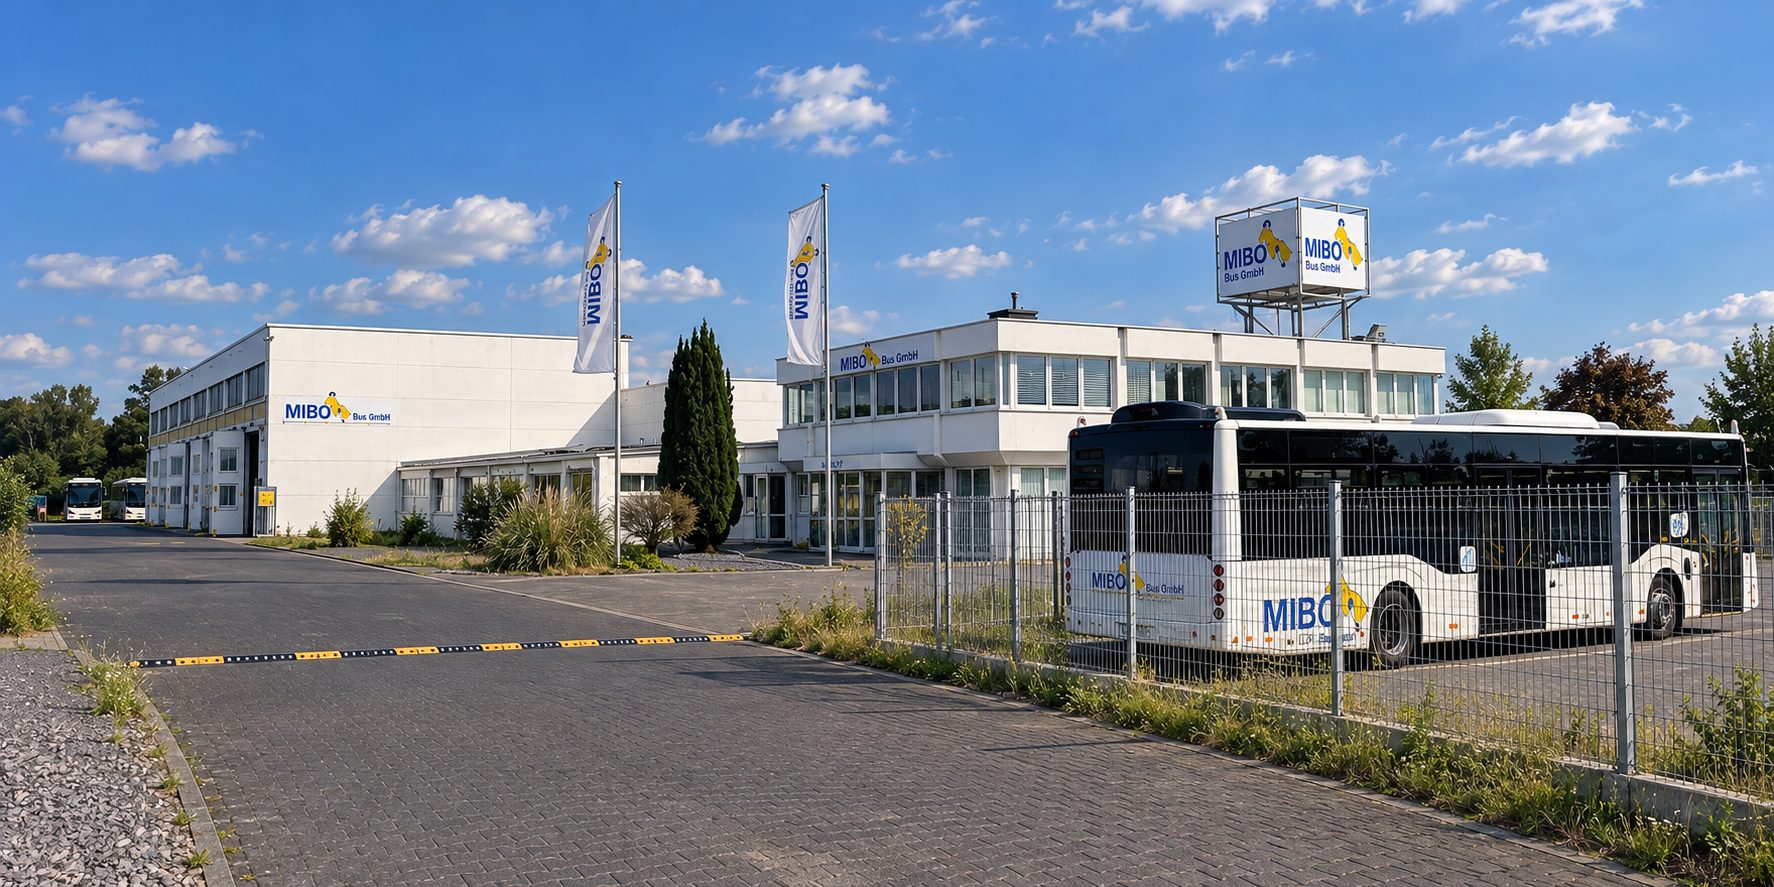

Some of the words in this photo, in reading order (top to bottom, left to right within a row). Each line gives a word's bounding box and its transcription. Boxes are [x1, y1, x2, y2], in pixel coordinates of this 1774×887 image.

[1224, 244, 1267, 271] MIBO
[1305, 237, 1342, 261] MIBO
[1224, 272, 1239, 283] Bus
[1240, 267, 1264, 280] GmbH
[1305, 260, 1319, 271] Bus
[1320, 263, 1341, 274] GmbH
[840, 354, 867, 372] MIBO
[896, 350, 918, 363] GmbH
[285, 403, 331, 419] MIBO
[352, 412, 367, 421] Bus
[368, 413, 390, 421] GmbH
[1092, 572, 1126, 590] MIBO
[1161, 584, 1184, 594] GmbH
